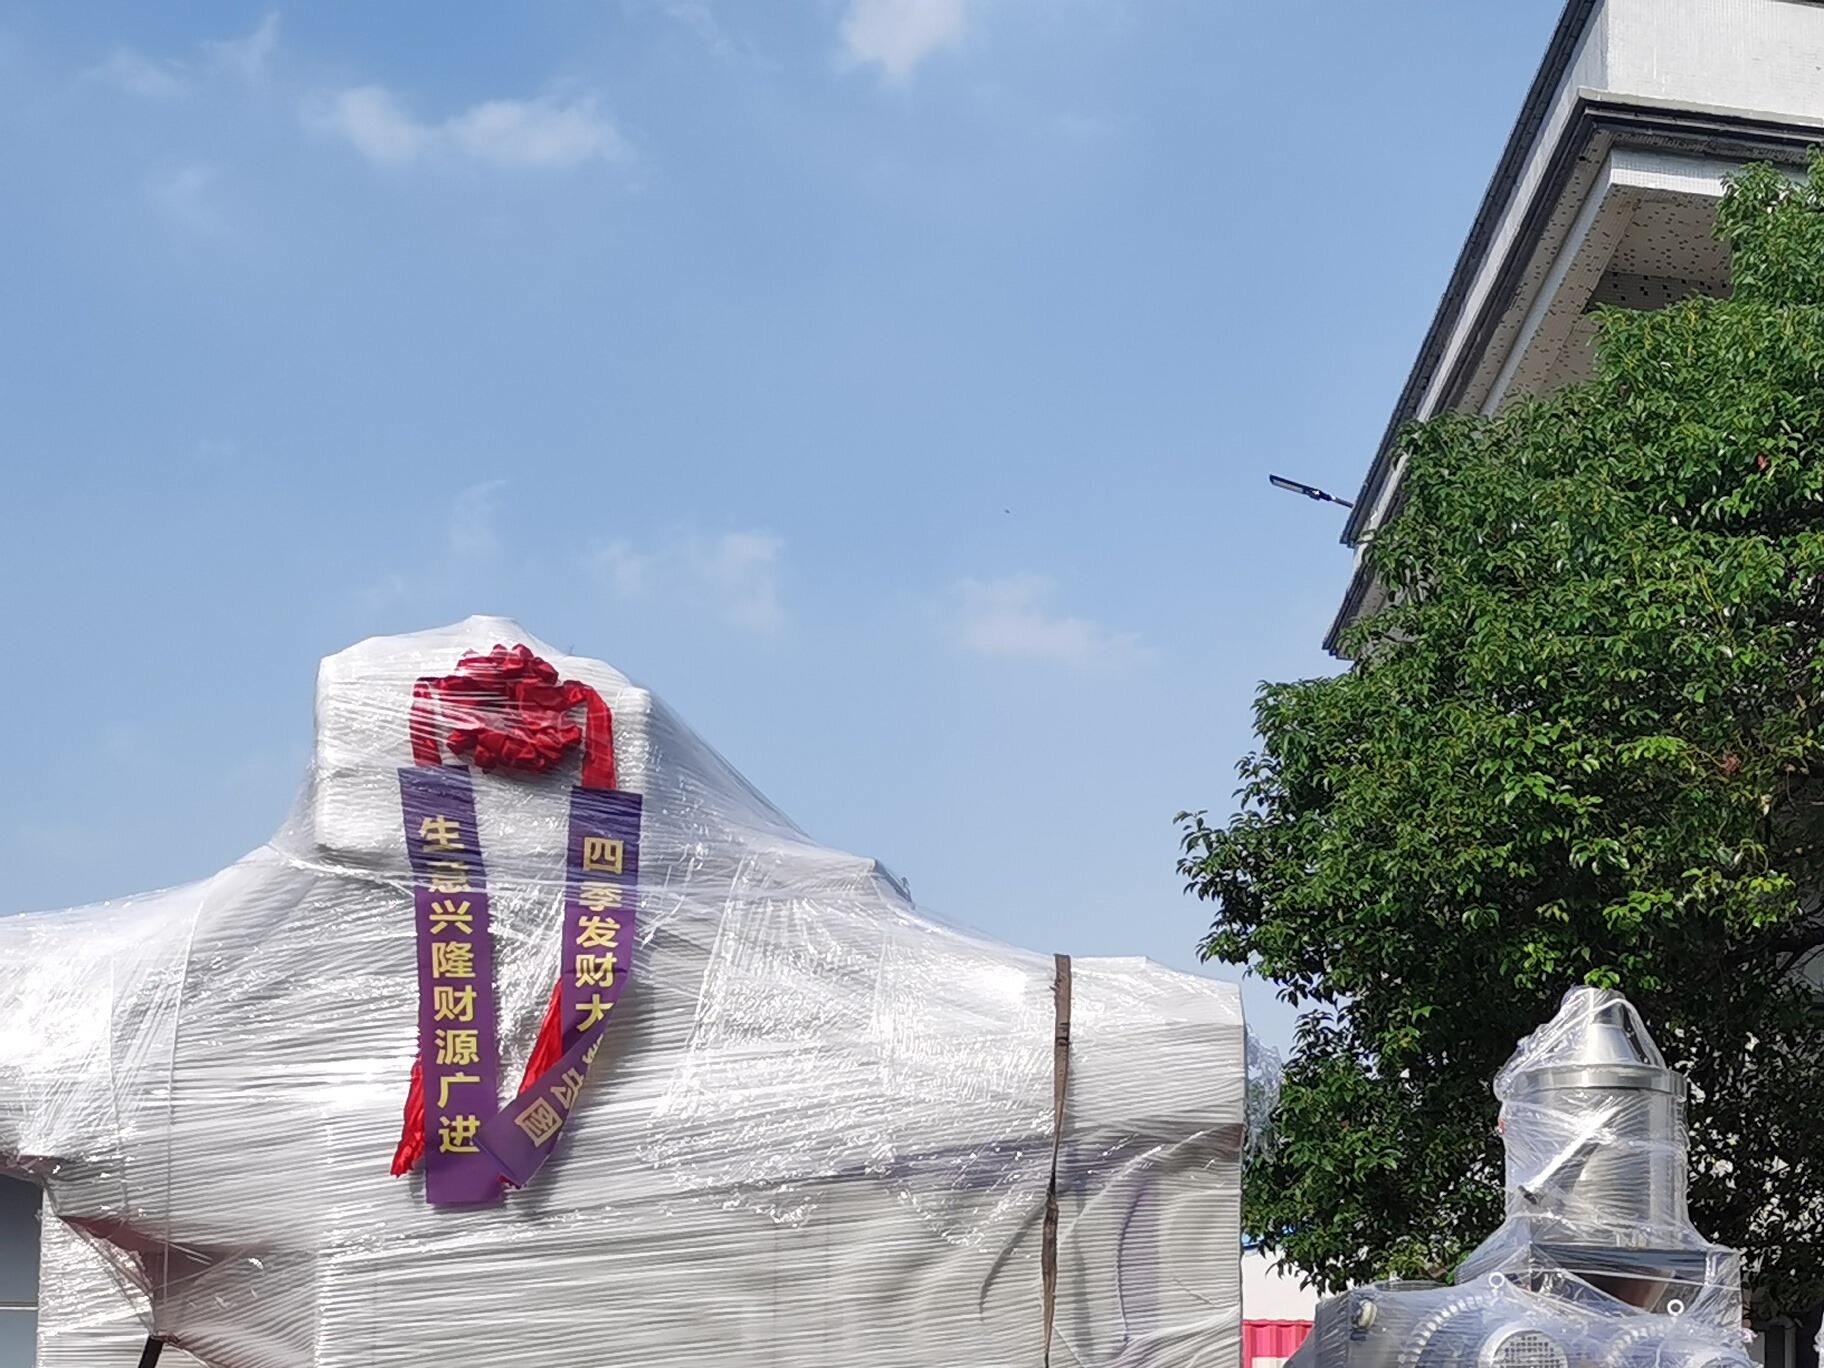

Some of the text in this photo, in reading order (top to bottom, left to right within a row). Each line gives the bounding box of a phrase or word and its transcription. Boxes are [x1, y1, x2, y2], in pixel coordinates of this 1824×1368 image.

[418, 814, 483, 1155] 生意兴隆财源广进
